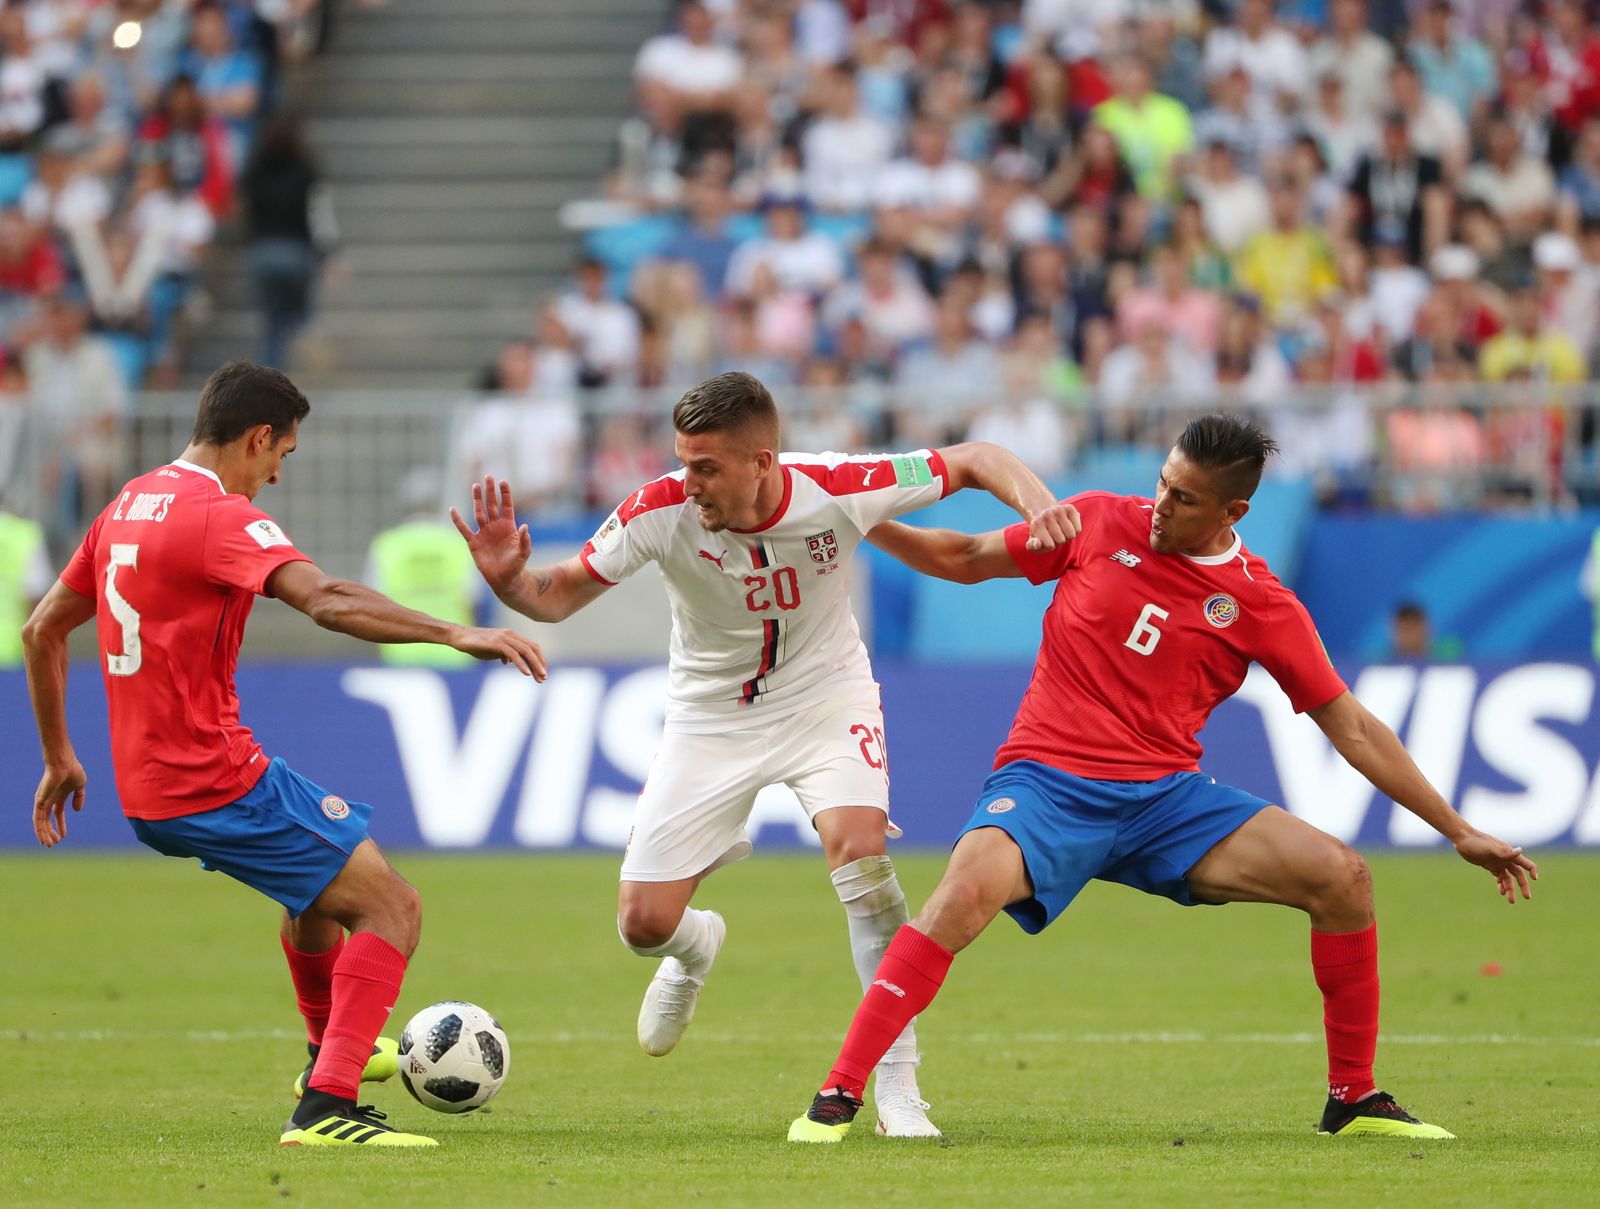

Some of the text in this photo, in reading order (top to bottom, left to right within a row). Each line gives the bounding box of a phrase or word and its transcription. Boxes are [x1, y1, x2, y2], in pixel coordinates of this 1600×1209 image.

[105, 543, 142, 676] 5
[744, 566, 802, 612] 20
[1122, 603, 1170, 656] 6
[339, 665, 817, 848] VIS
[1228, 661, 1600, 848] VIS
